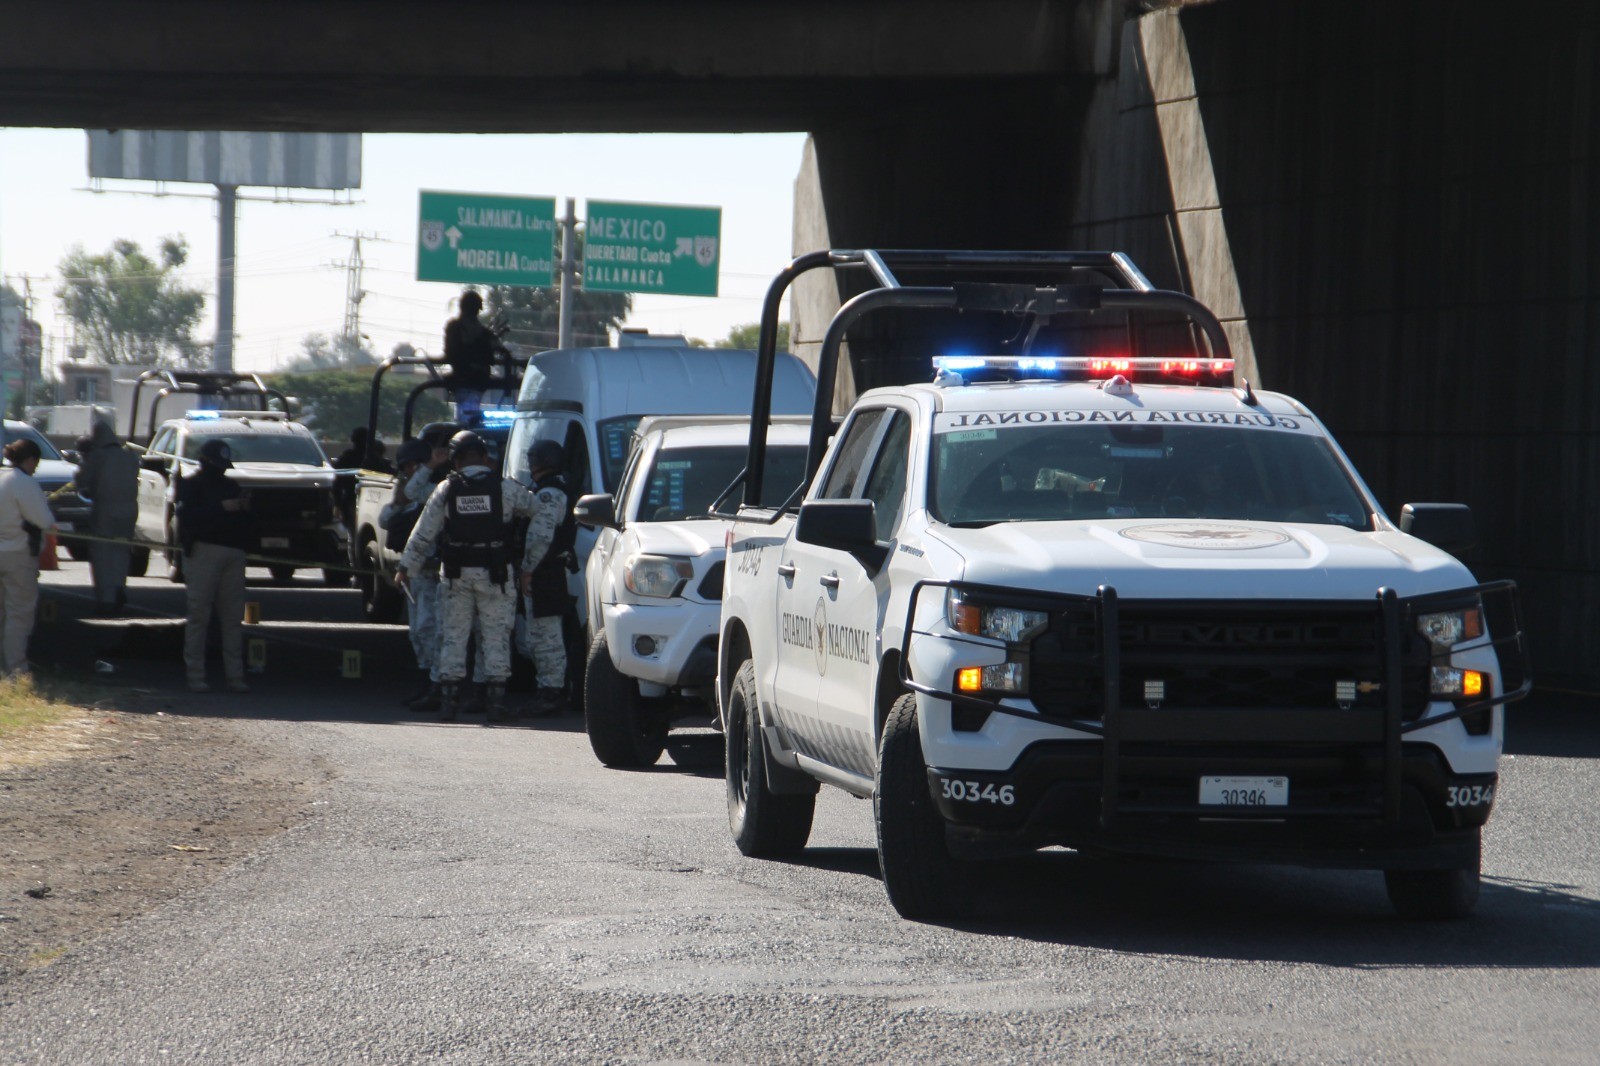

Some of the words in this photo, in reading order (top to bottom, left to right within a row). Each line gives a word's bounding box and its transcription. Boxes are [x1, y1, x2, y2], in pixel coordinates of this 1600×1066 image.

[457, 206, 523, 229] SALAMANCA
[426, 231, 438, 242] 45
[589, 216, 667, 242] MEXICO
[457, 248, 518, 271] MORELIA
[586, 243, 638, 262] QUERETARO
[699, 246, 712, 257] 45
[587, 265, 664, 286] SALAMANCA
[782, 612, 814, 650] GUARDIA
[828, 623, 870, 665] NACIONAL
[940, 778, 1015, 805] 30346
[1221, 789, 1266, 805] 30346
[1446, 785, 1493, 807] 3034
